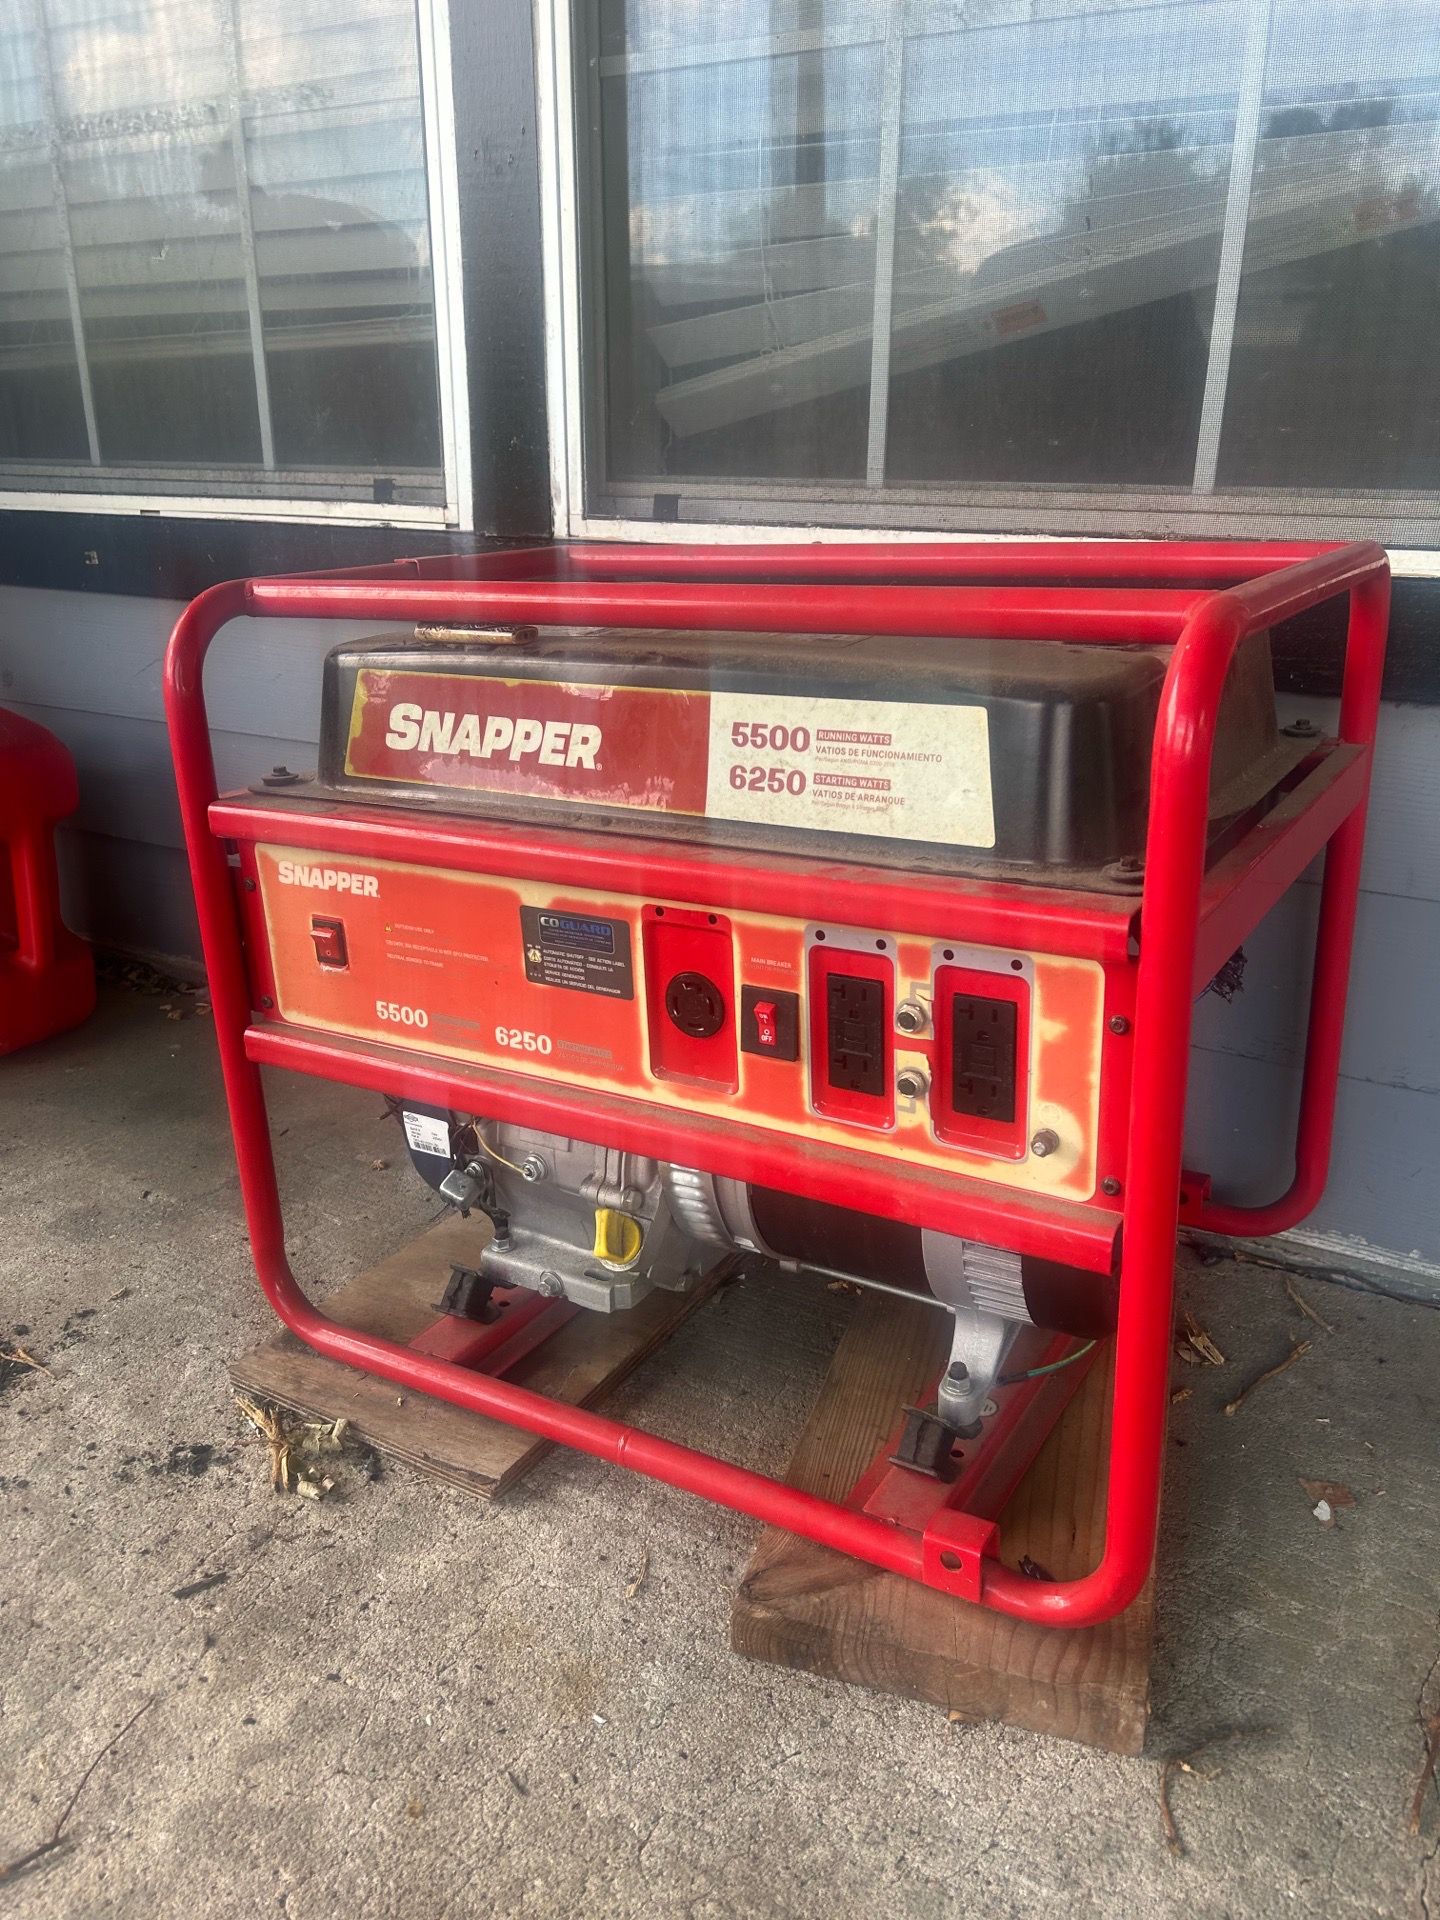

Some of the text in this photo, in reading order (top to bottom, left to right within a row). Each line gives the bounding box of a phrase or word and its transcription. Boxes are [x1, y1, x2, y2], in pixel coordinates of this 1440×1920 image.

[385, 702, 602, 769] SNAPPER
[731, 721, 811, 752] 5500
[818, 730, 890, 745] RUNNING WATTS
[816, 745, 942, 763] VATIOS DE FUNCIONAMIENTO
[729, 764, 807, 796] 6250
[815, 775, 890, 790] STARTING WATTS
[812, 789, 905, 806] VATIOS DE ARRANQUE
[278, 860, 379, 898] SNAPPER
[751, 957, 792, 968] MAIN BREAKER
[375, 1000, 428, 1028] 5500
[494, 1026, 552, 1055] 6250
[761, 1034, 772, 1042] OFF
